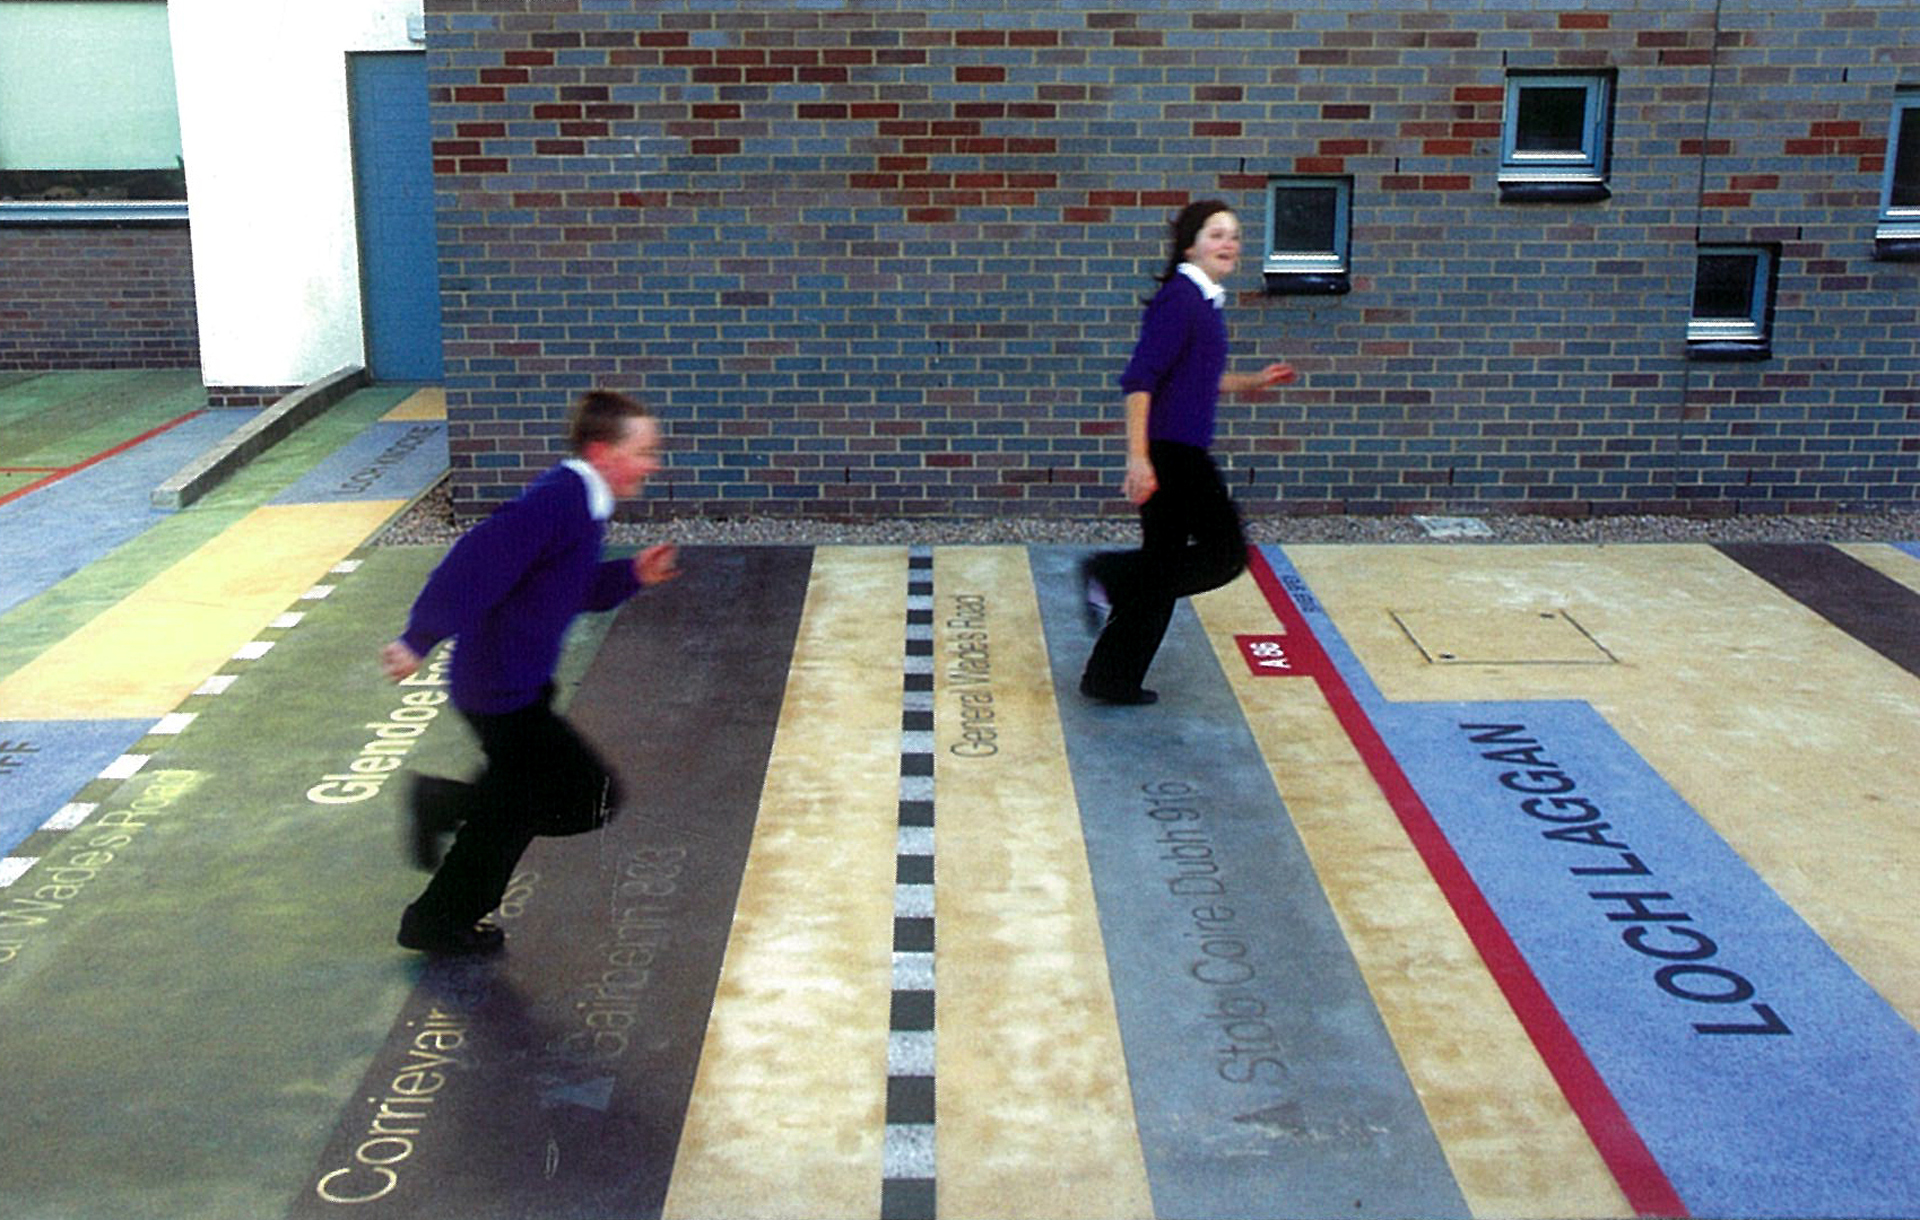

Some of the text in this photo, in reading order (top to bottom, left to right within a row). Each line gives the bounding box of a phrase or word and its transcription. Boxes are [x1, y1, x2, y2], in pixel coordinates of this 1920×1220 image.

[947, 594, 987, 629] Road
[306, 690, 449, 804] Glendoe
[949, 690, 998, 758] General
[0, 769, 199, 928] Wade's Road
[1458, 723, 1793, 1035] LOCH LAGGAN
[1141, 781, 1289, 1084] Stob Coire Dubh 916
[317, 1008, 467, 1203] Corrieyair
